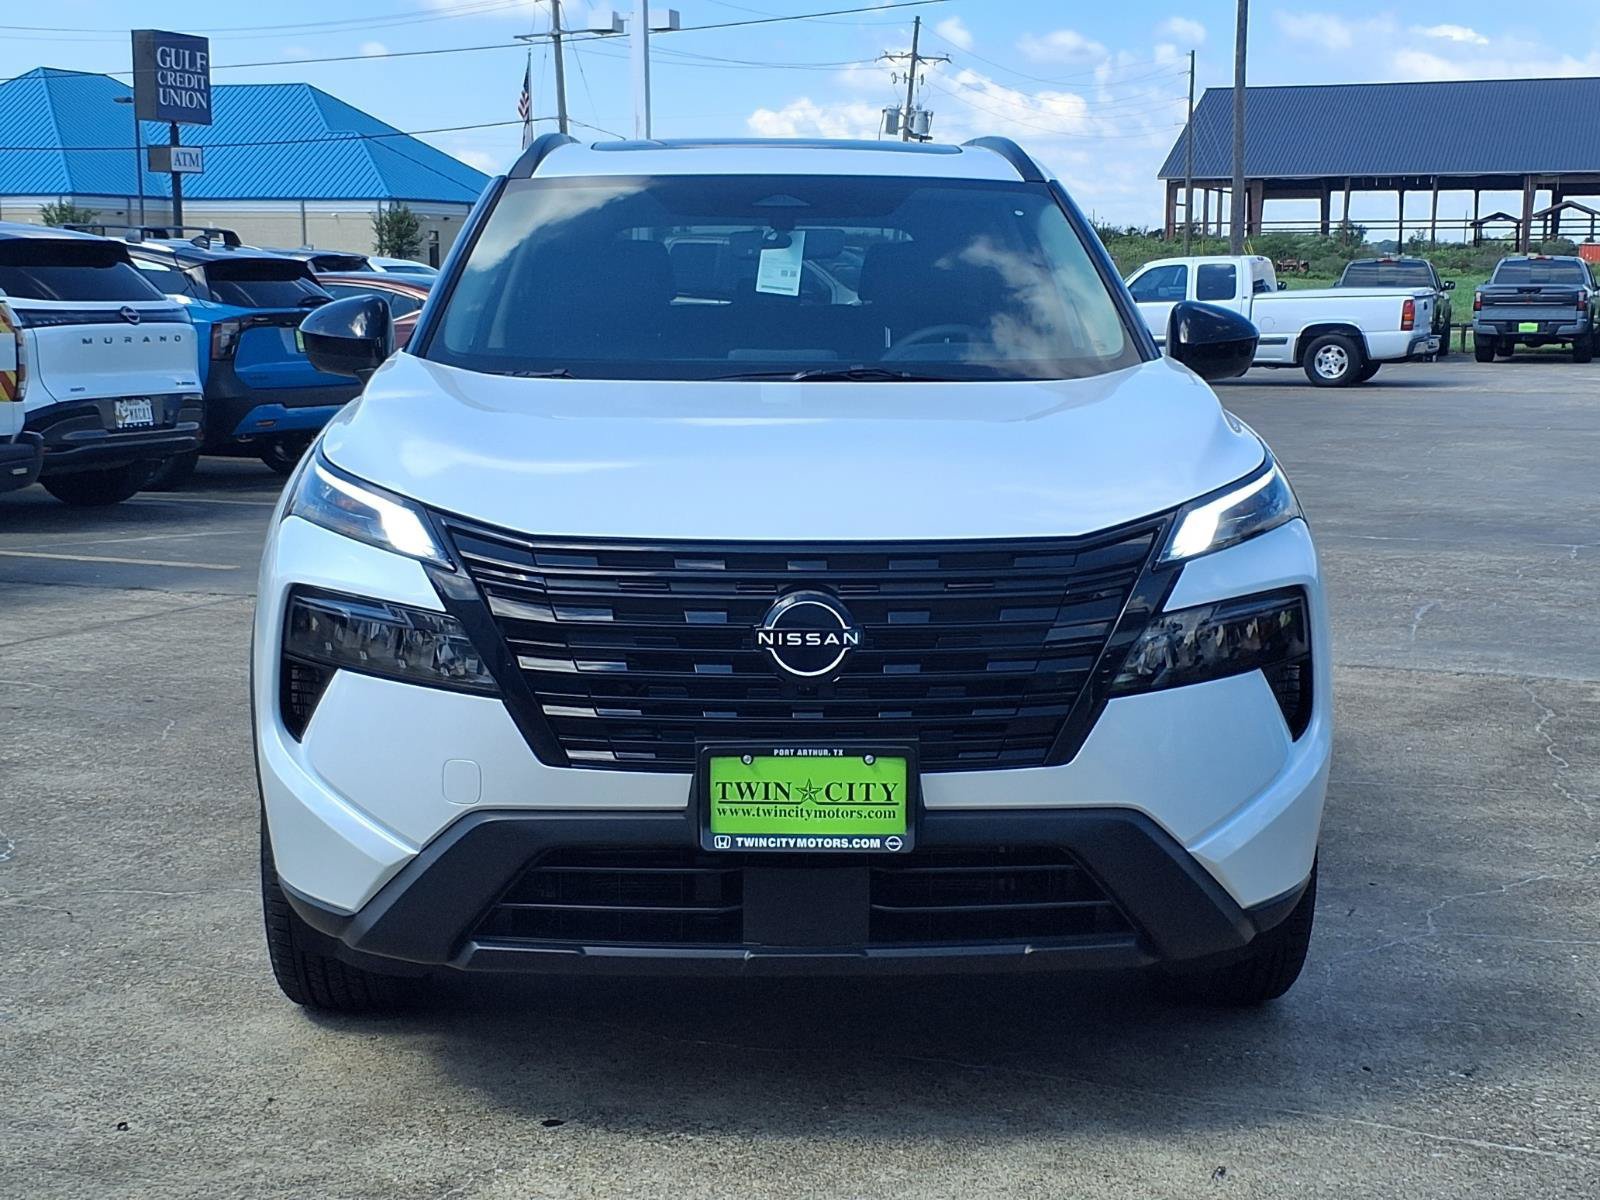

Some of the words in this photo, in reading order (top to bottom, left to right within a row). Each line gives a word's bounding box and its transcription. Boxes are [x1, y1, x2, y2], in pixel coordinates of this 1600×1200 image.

[157, 46, 207, 73] GULF
[157, 70, 208, 90] CREDIT
[158, 87, 208, 109] UNION
[173, 152, 201, 168] ATM
[82, 335, 182, 345] MURANO
[757, 631, 859, 646] NISSAN
[773, 748, 794, 756] PORT
[833, 748, 844, 756] TX
[715, 781, 793, 801] TWIN
[824, 781, 900, 802] CITY
[716, 805, 897, 821] www.twincitymotors.com
[735, 837, 881, 849] TWINCITYMOTORS.COM
